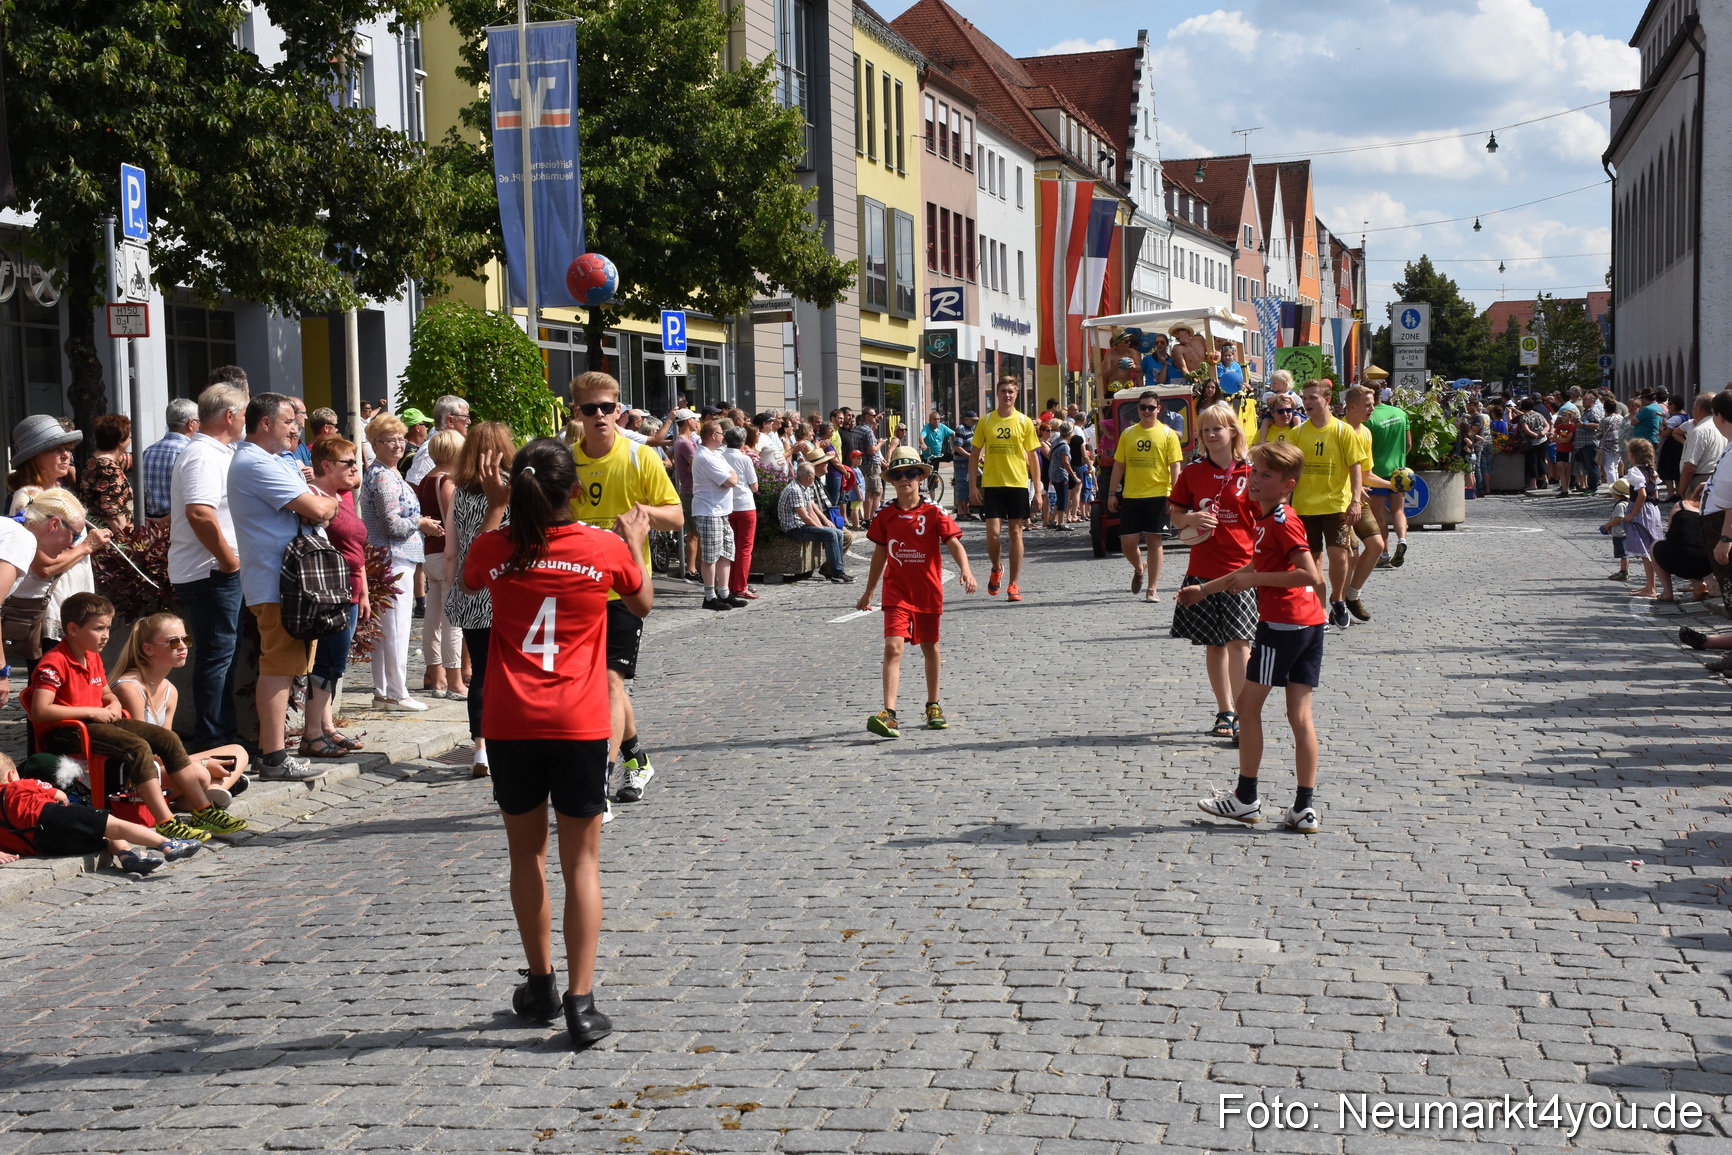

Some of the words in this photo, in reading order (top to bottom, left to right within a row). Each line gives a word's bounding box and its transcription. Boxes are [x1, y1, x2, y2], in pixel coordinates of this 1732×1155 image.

[127, 175, 141, 228] P
[117, 306, 138, 315] H150
[667, 316, 681, 346] P
[996, 427, 1011, 440] 23
[1136, 439, 1152, 452] 99
[1315, 441, 1324, 456] 11
[589, 482, 603, 507] 9
[1235, 476, 1247, 497] 9
[915, 514, 926, 536] 3
[522, 596, 560, 672] 4
